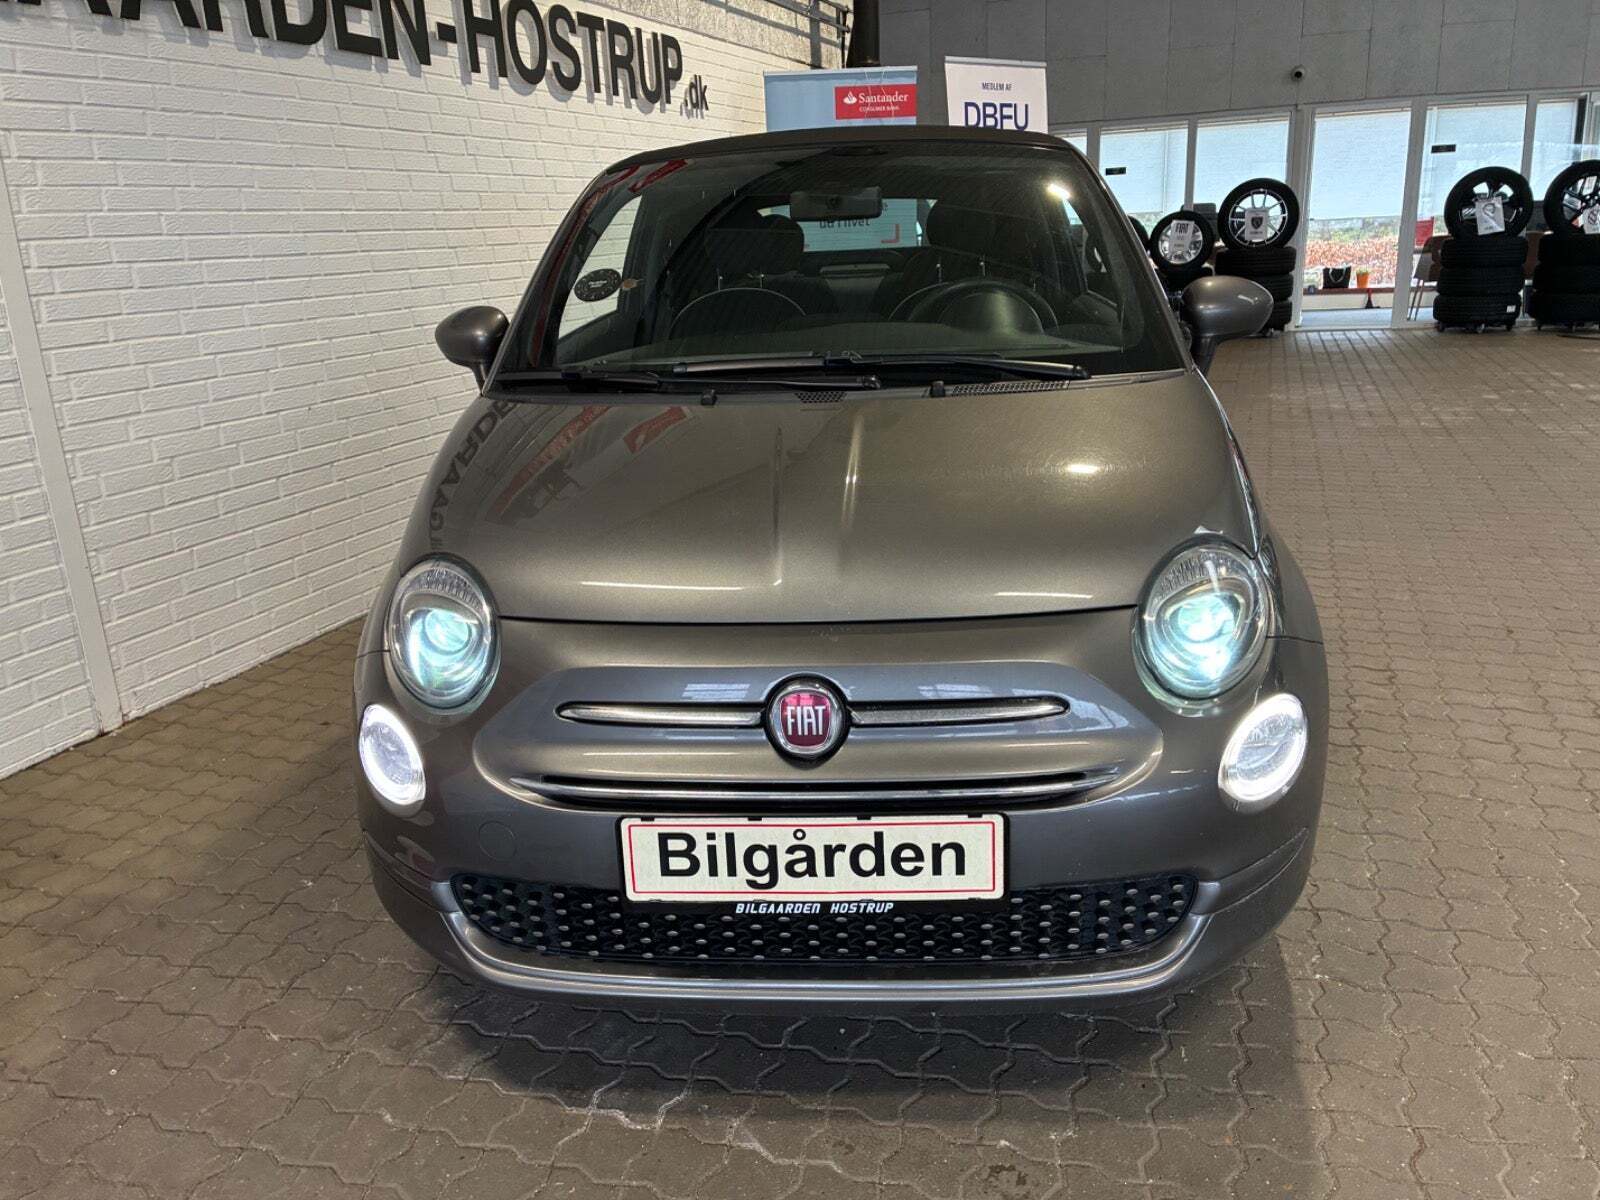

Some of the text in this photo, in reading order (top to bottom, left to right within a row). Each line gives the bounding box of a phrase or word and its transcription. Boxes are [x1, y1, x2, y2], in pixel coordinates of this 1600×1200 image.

[982, 82, 1012, 91] MEDLEM AF
[858, 91, 909, 104] Santander
[964, 102, 1029, 131] DBFU
[786, 705, 826, 736] FIAT
[657, 828, 966, 890] Bilgården
[735, 902, 894, 914] BILGAARDEN HOSTRUP
